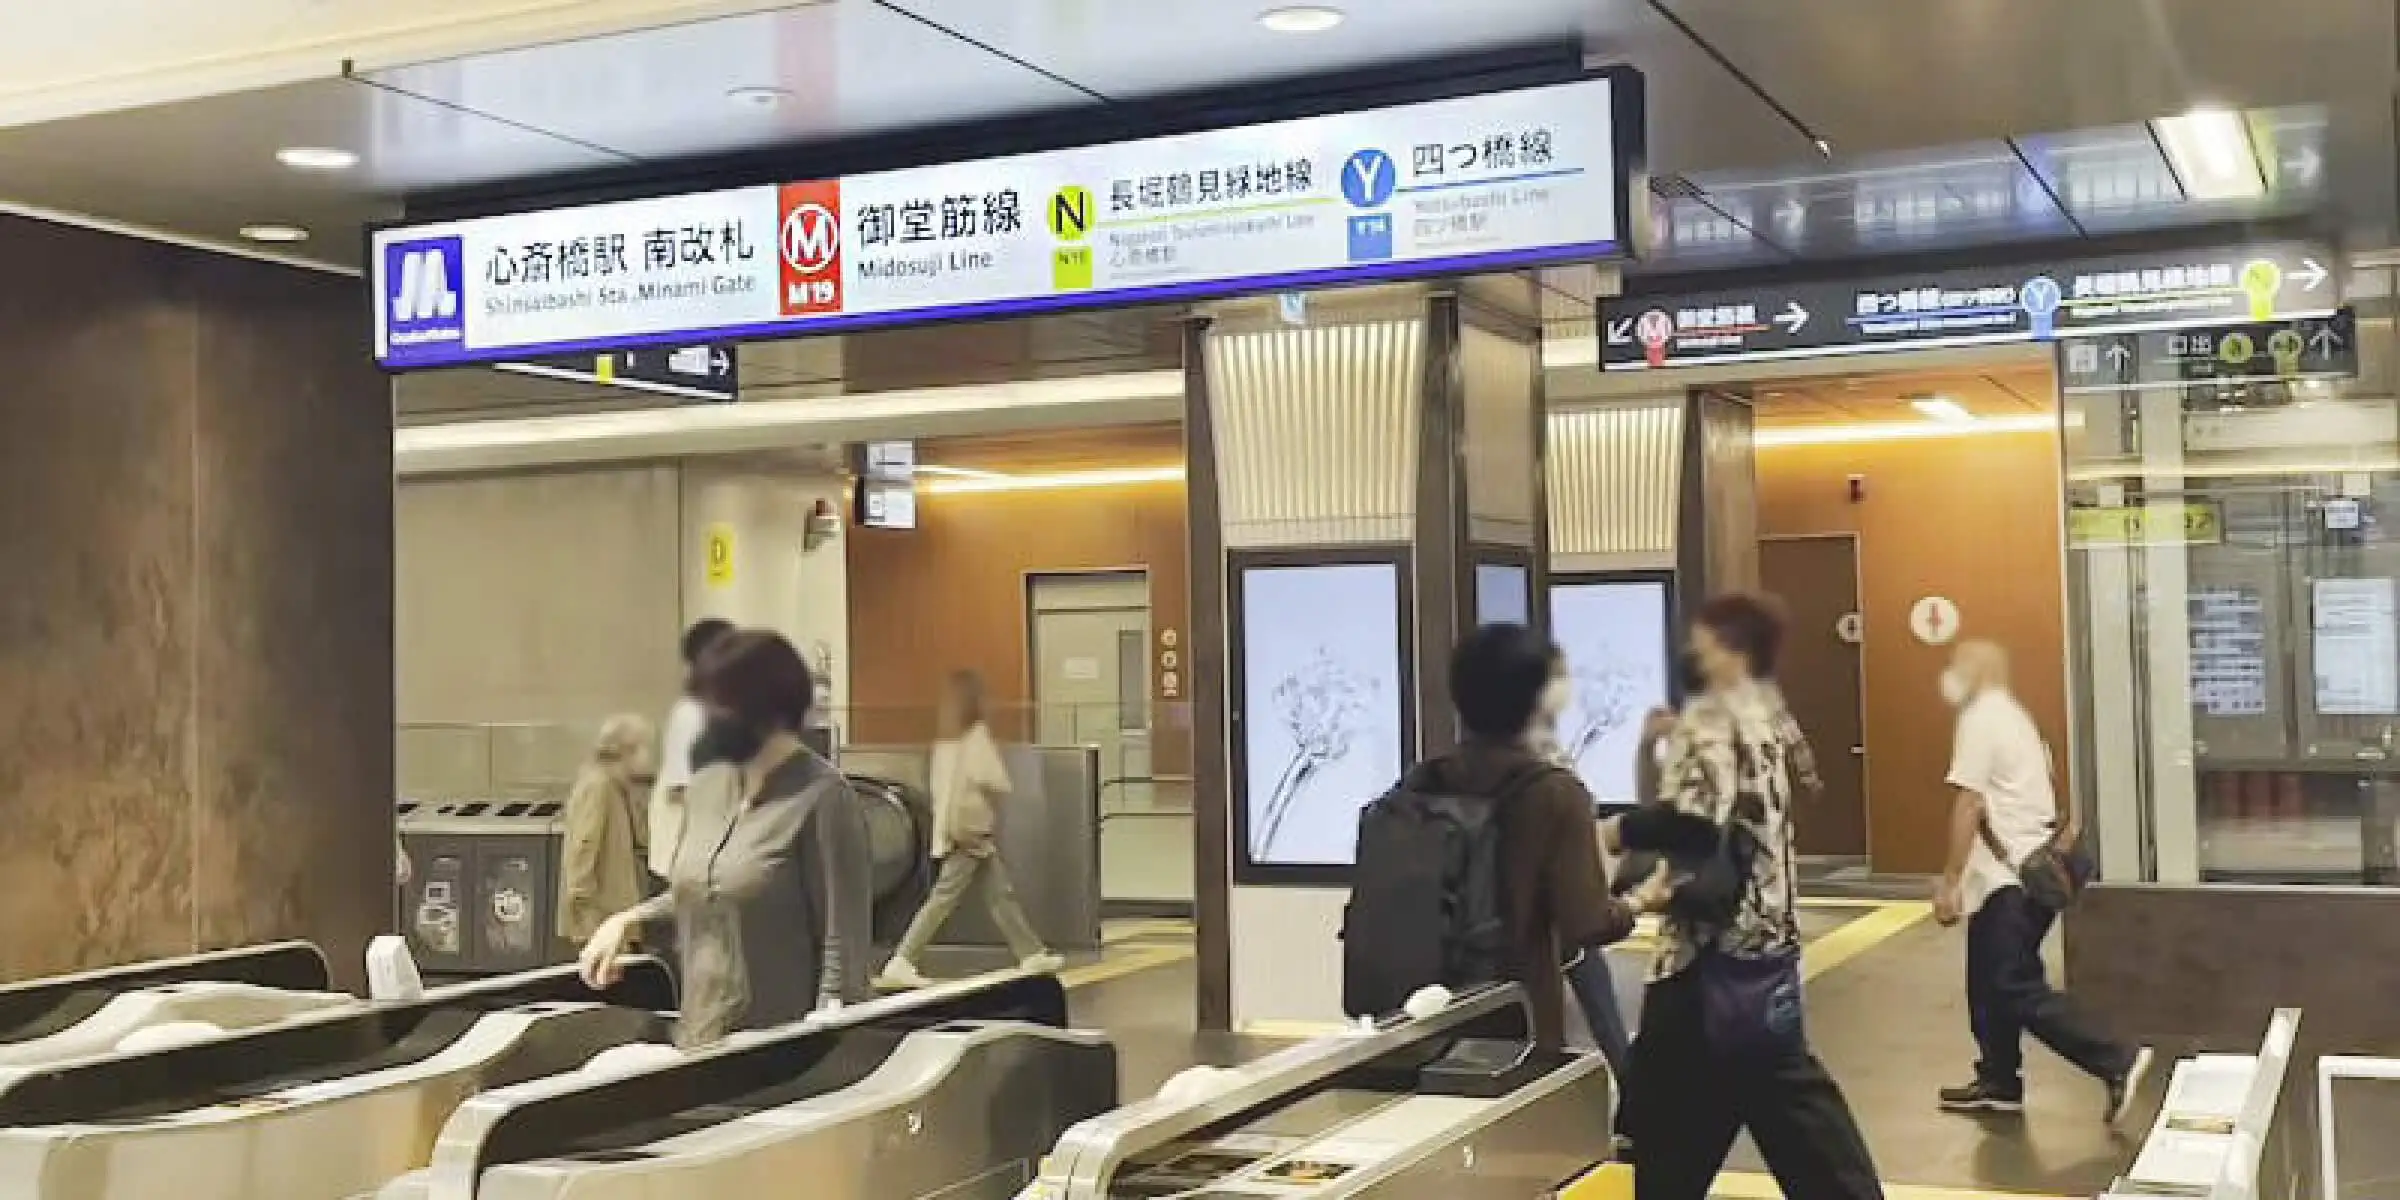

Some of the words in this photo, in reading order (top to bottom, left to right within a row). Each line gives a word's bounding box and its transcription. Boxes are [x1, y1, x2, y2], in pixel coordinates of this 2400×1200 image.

[1412, 129, 1553, 177] 四つ橋線
[1110, 158, 1313, 212] 長堀鶴見緑地線
[857, 188, 1021, 248] 御堂筋線
[485, 232, 628, 286] 心斎橋駅
[642, 217, 755, 272] 南改札
[857, 251, 943, 281] Midosuji
[950, 248, 994, 271] Line
[711, 273, 756, 296] Gate
